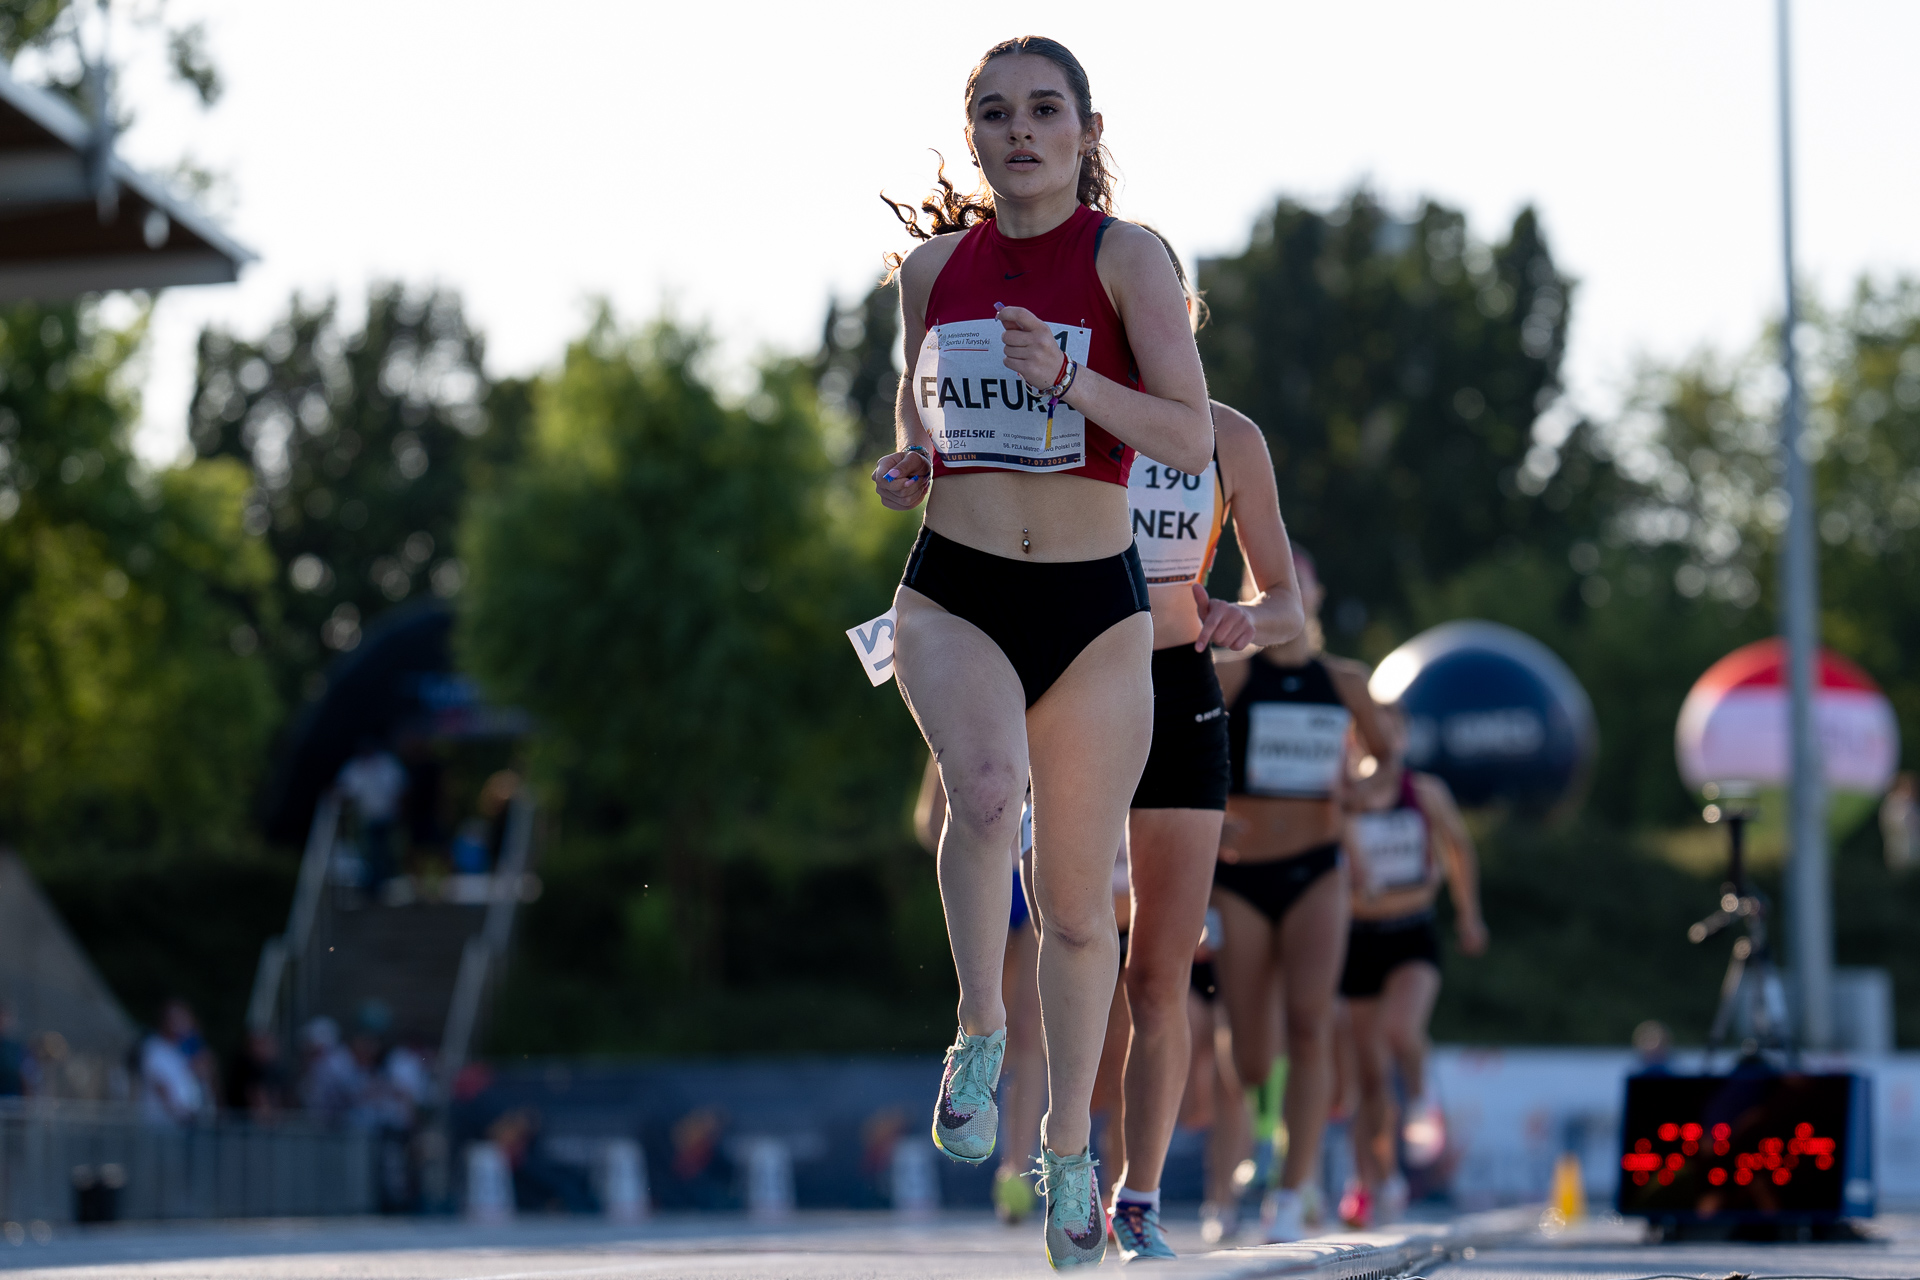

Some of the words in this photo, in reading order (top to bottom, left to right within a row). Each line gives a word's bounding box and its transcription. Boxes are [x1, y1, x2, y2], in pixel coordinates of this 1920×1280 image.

[920, 376, 1076, 413] FALFUR
[939, 429, 995, 438] LUBELSKIE
[940, 439, 967, 449] 2024
[1145, 465, 1200, 491] 190
[1130, 508, 1200, 540] NEK
